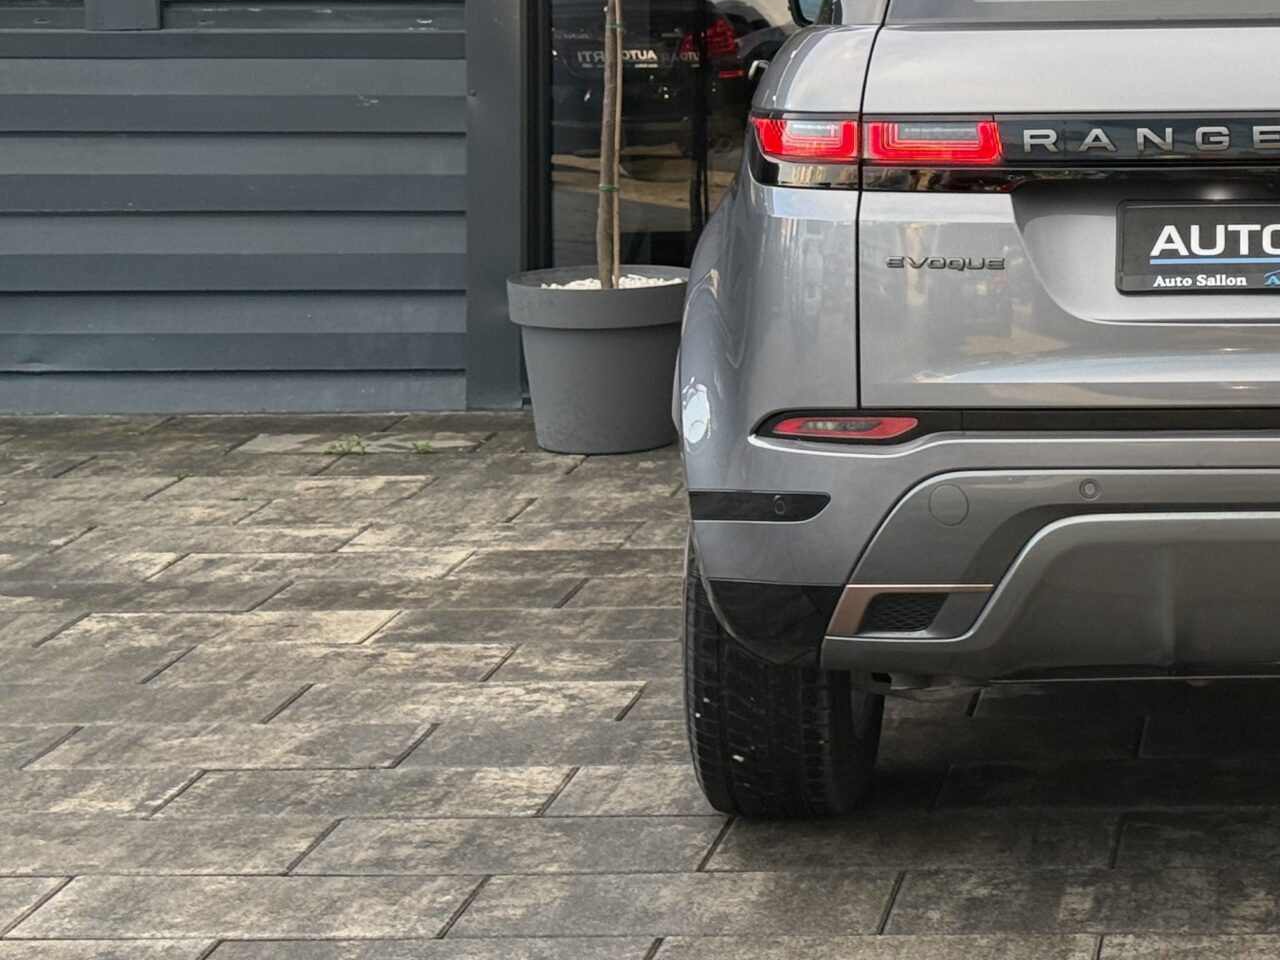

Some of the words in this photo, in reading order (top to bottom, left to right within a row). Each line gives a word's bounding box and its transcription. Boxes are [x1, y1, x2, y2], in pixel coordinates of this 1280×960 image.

[886, 256, 1005, 271] EVOQUE
[1153, 275, 1193, 287] Auto
[1196, 274, 1247, 287] Sallon
